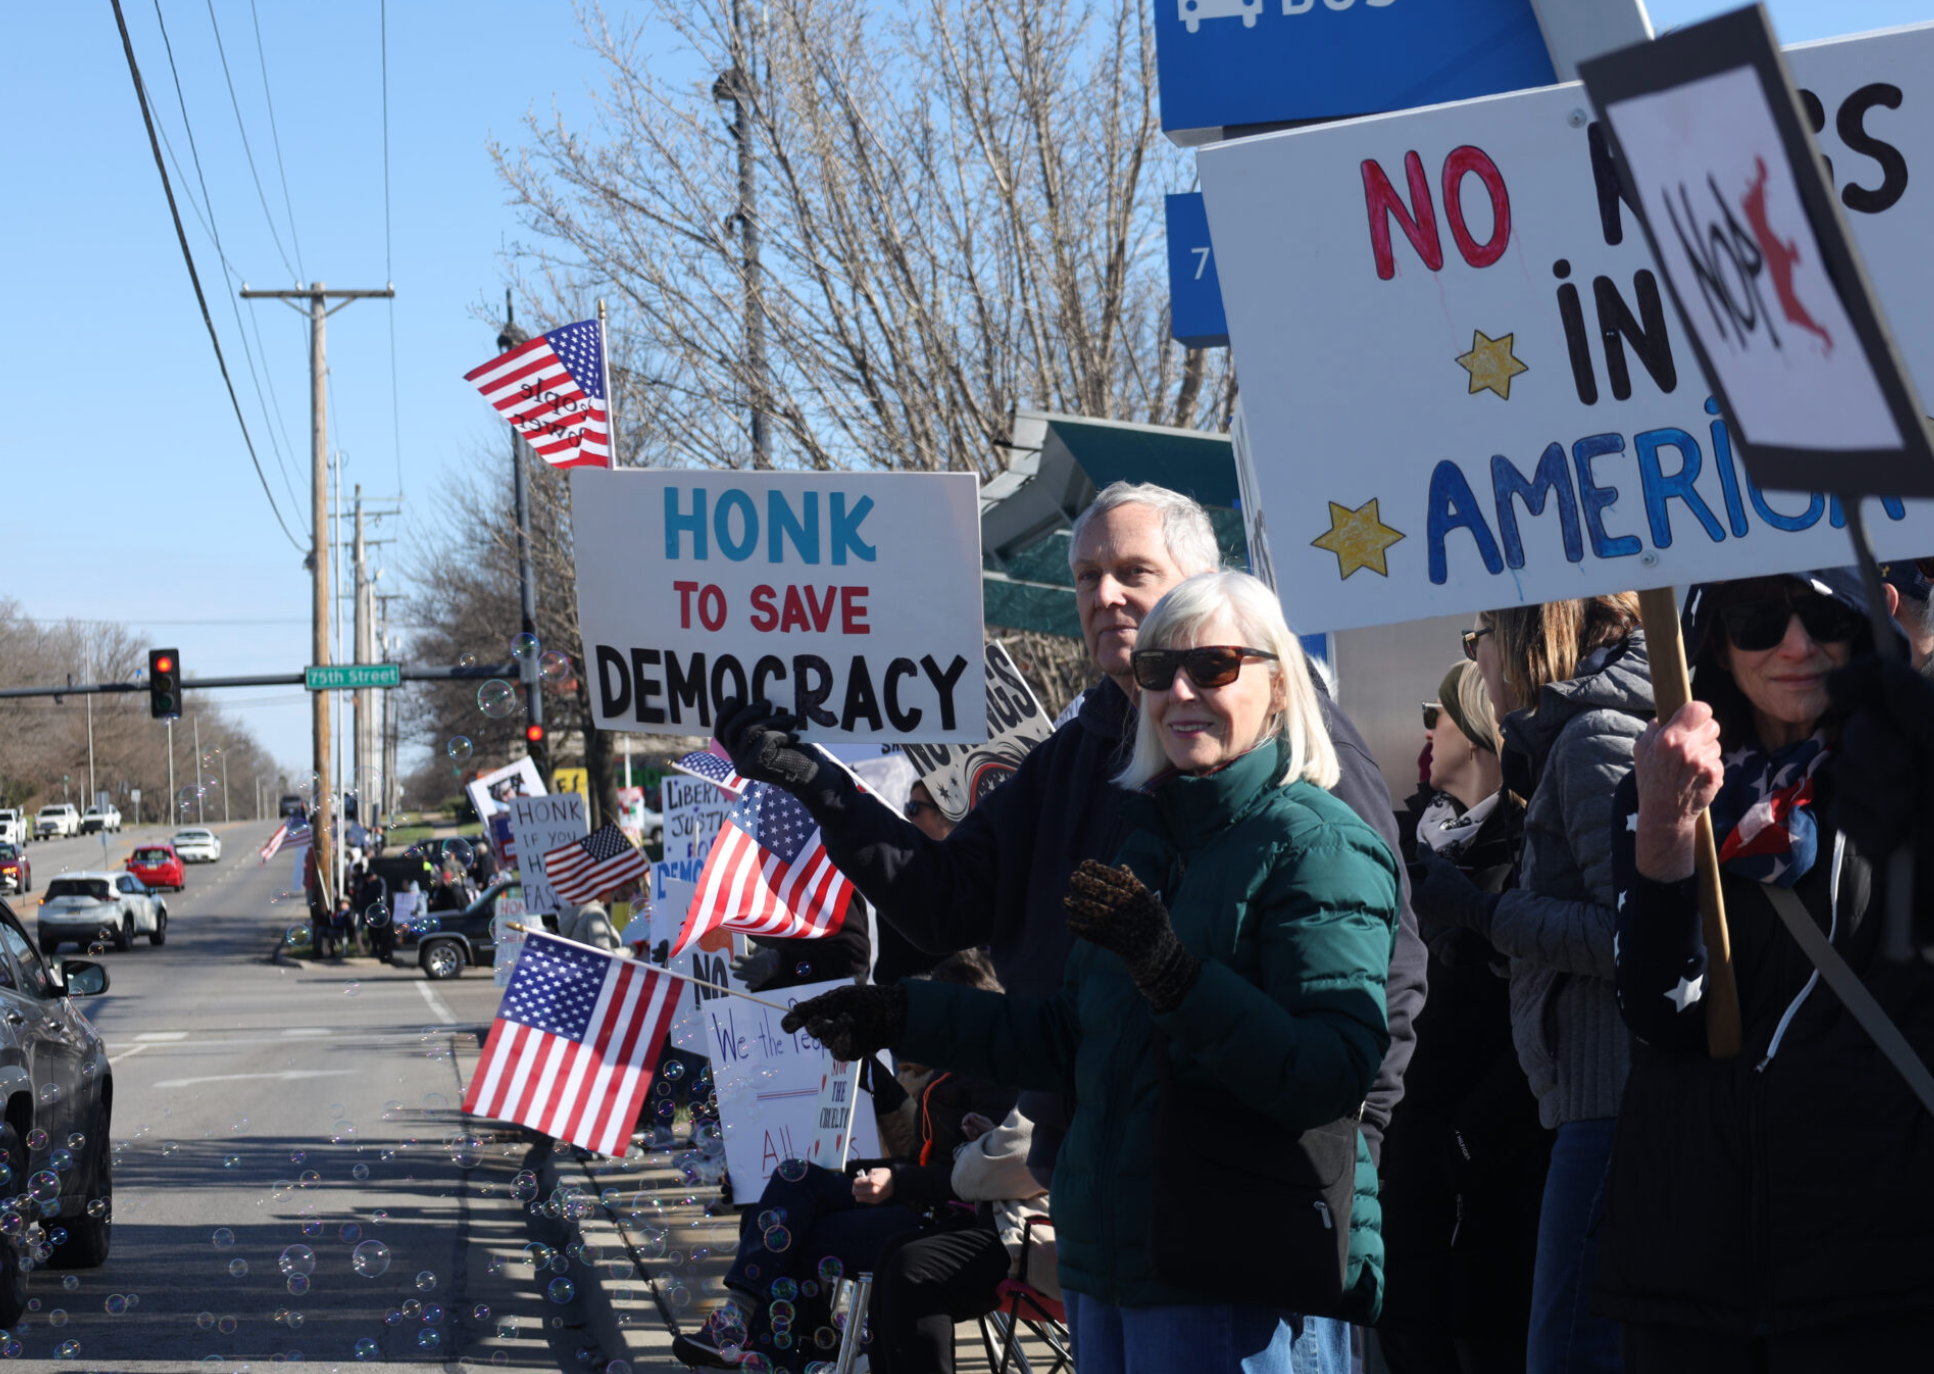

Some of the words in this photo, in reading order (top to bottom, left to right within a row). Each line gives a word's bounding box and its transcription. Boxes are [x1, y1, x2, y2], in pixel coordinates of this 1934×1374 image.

[1360, 145, 1511, 281] NO
[664, 487, 877, 565] HONK
[673, 581, 727, 632] TO
[750, 584, 871, 634] SAVE
[310, 669, 344, 685] 75th
[348, 668, 396, 684] Street
[595, 645, 968, 733] DEMOCRACY
[516, 800, 583, 826] HONK
[524, 834, 540, 848] IF
[549, 831, 577, 847] YOU
[712, 1007, 749, 1063] We
[758, 1008, 784, 1059] the
[832, 1081, 848, 1103] THE
[820, 1107, 850, 1129] CRUELTY
